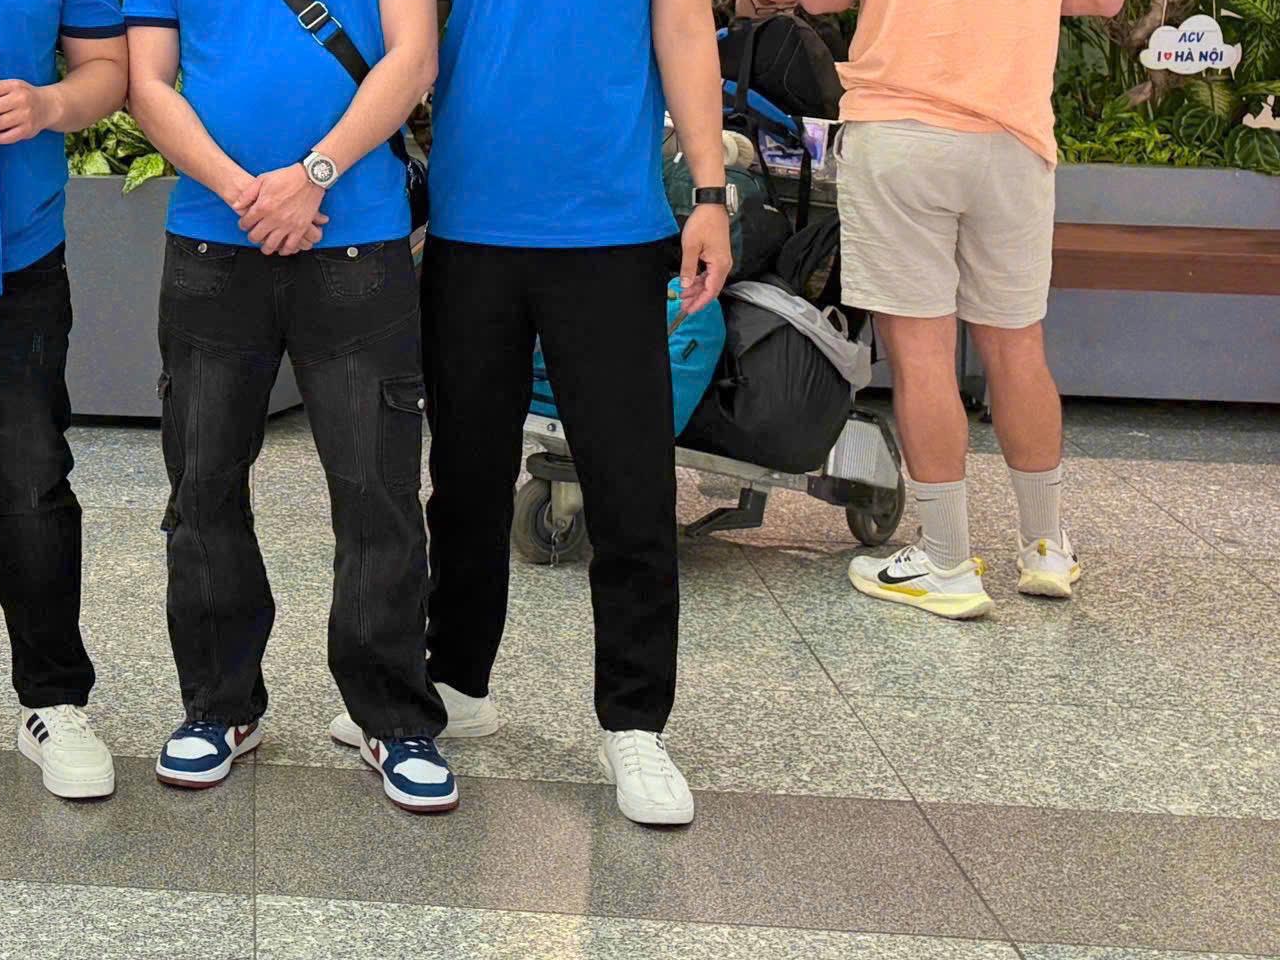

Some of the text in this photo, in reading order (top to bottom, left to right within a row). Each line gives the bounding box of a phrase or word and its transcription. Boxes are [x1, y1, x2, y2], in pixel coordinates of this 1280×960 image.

[1178, 31, 1205, 43] ACV
[1174, 47, 1194, 62] HÀ
[1198, 47, 1224, 65] NỘI
